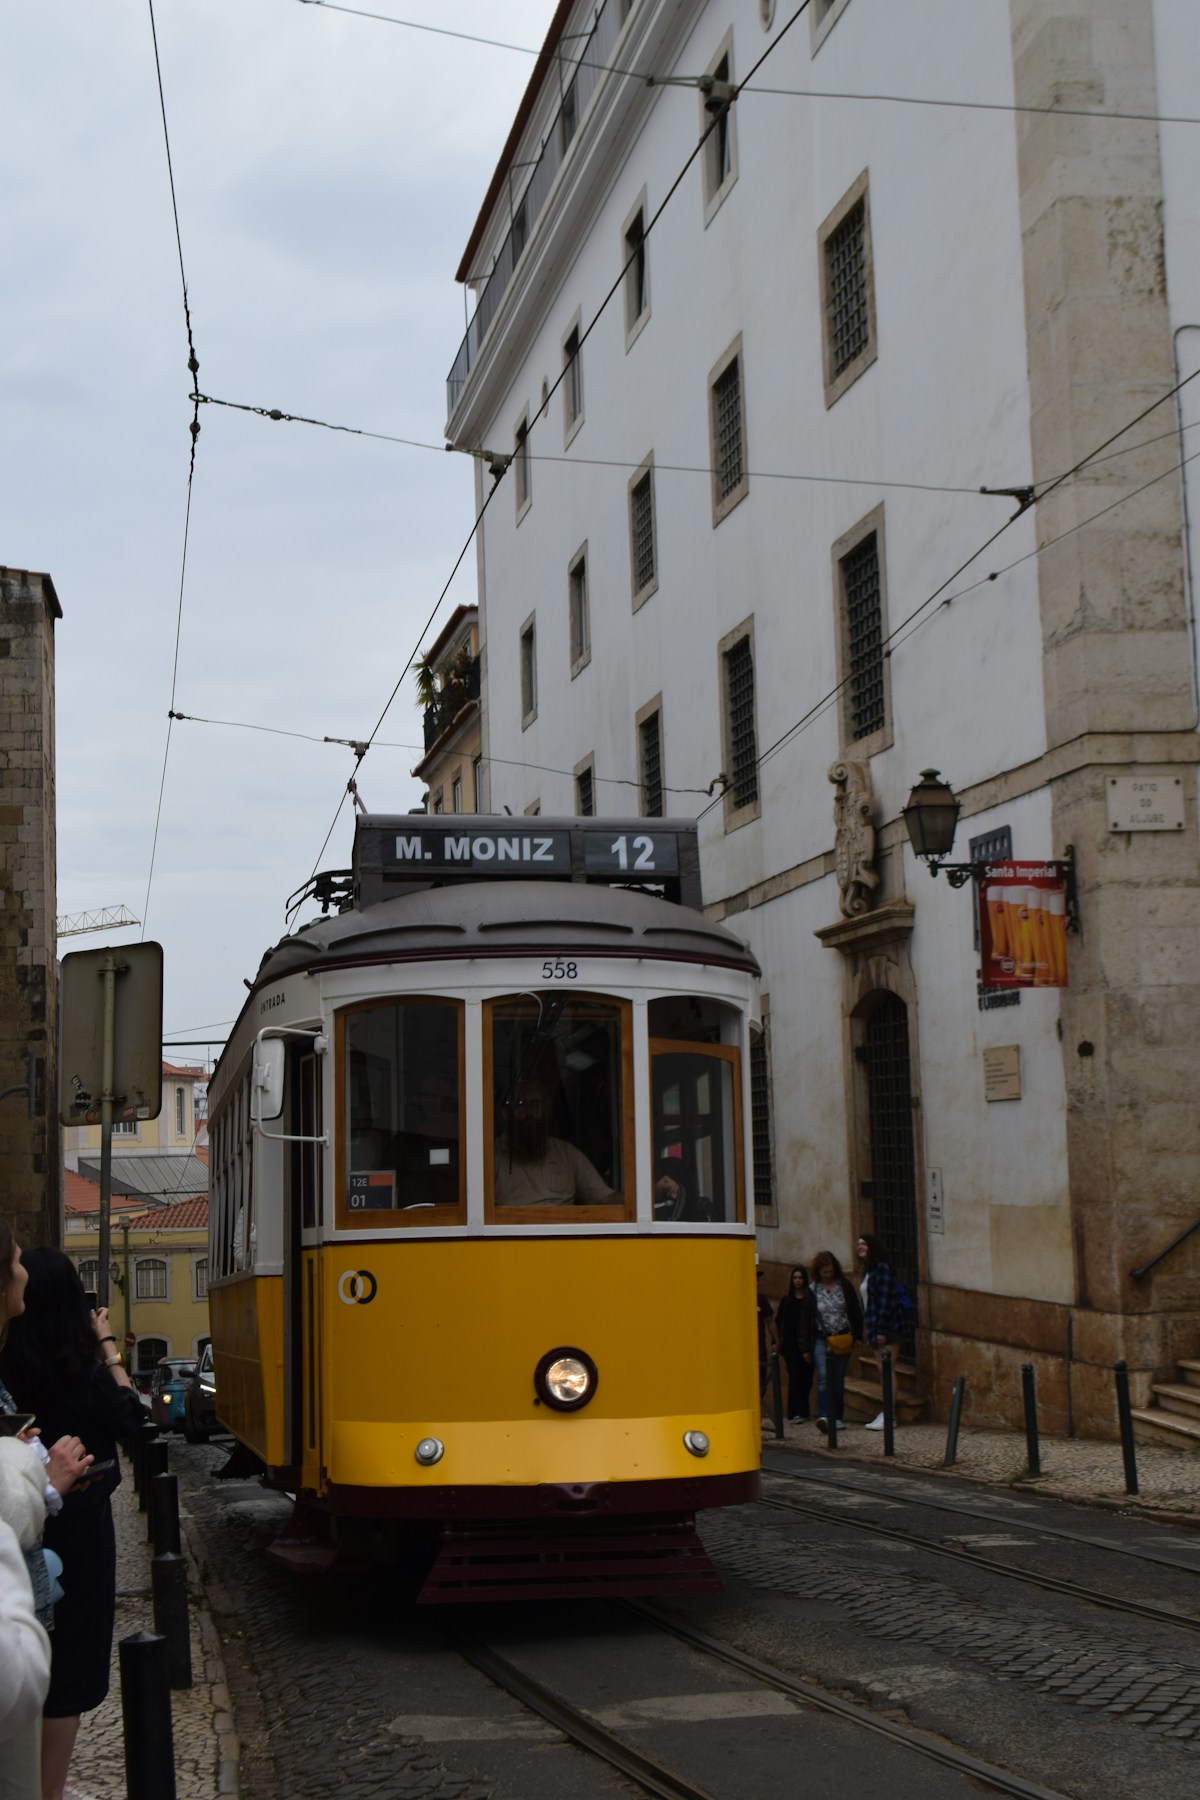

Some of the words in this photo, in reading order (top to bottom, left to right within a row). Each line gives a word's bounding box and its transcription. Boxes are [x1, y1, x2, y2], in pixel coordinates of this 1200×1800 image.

[395, 836, 432, 860] M.
[444, 837, 554, 861] MONIZ
[611, 836, 655, 870] 12
[985, 866, 1014, 878] Santa
[1016, 866, 1057, 880] Imperial
[542, 962, 578, 979] 558
[260, 992, 286, 1015] ENTRADA
[352, 1178, 367, 1187] 12E
[351, 1194, 366, 1207] 01
